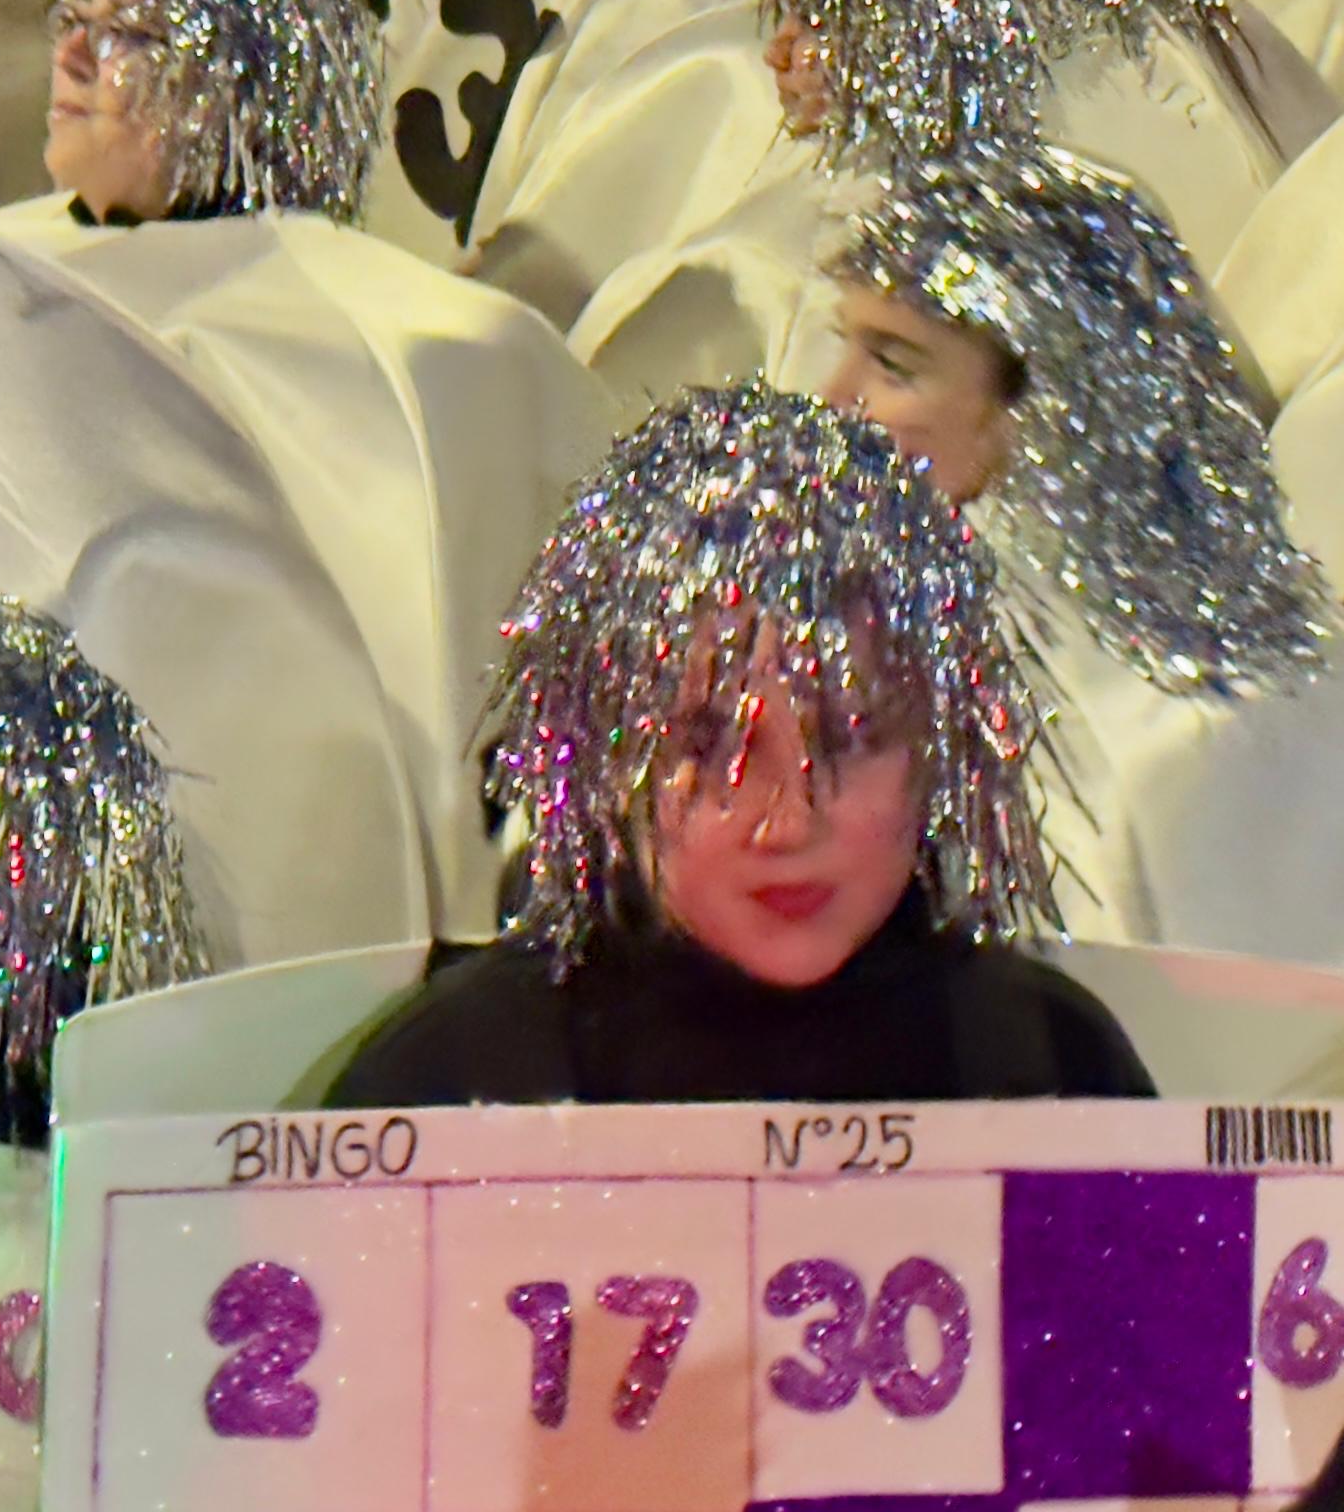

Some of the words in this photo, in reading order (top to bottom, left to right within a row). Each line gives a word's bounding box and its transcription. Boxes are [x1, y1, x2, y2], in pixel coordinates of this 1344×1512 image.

[216, 1116, 419, 1185] BINGO
[205, 1261, 323, 1439] 2
[505, 1275, 699, 1432] 17
[763, 1255, 972, 1419] 30
